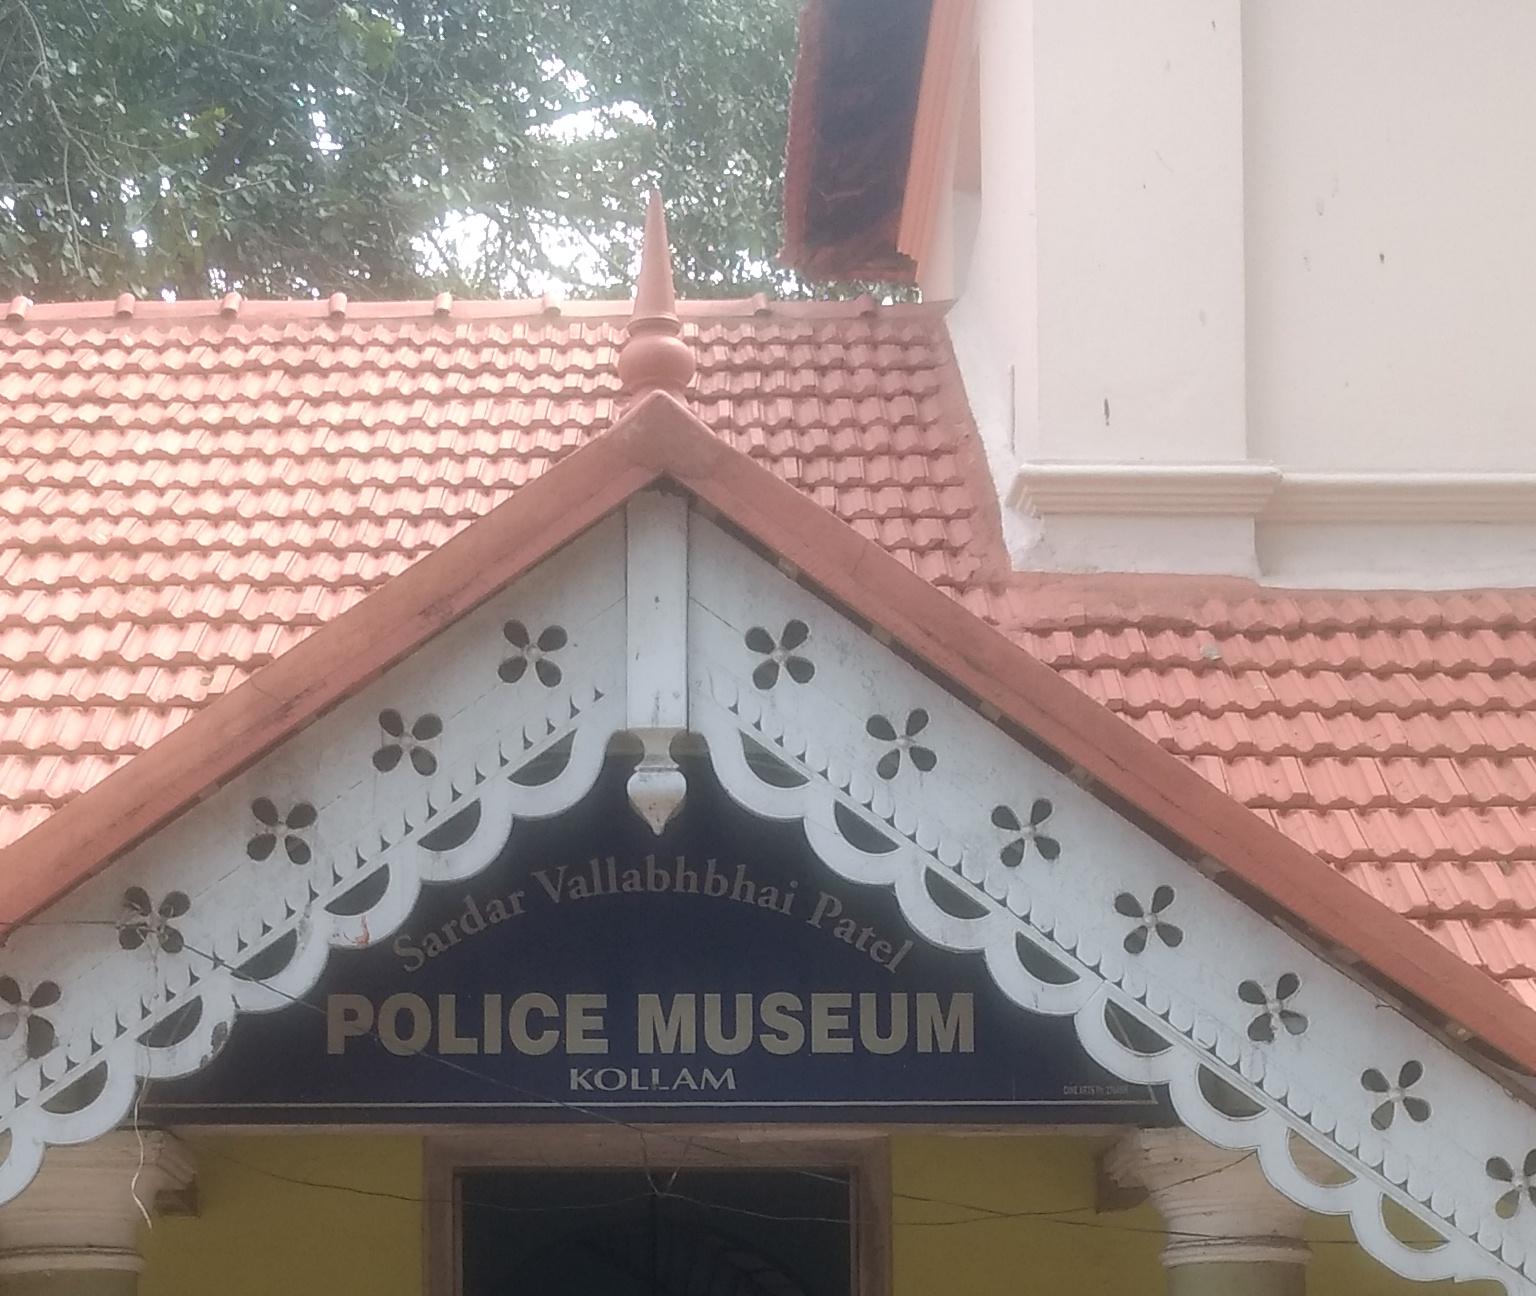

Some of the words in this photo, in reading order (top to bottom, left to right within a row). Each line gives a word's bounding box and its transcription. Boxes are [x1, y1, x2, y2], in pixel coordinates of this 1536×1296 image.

[393, 891, 527, 973] Sardar
[530, 854, 799, 916] Vallabhbhai
[806, 891, 914, 974] Patel
[327, 991, 609, 1056] POLICE
[638, 991, 976, 1056] MUSEUM
[569, 1067, 738, 1092] KOLLAM
